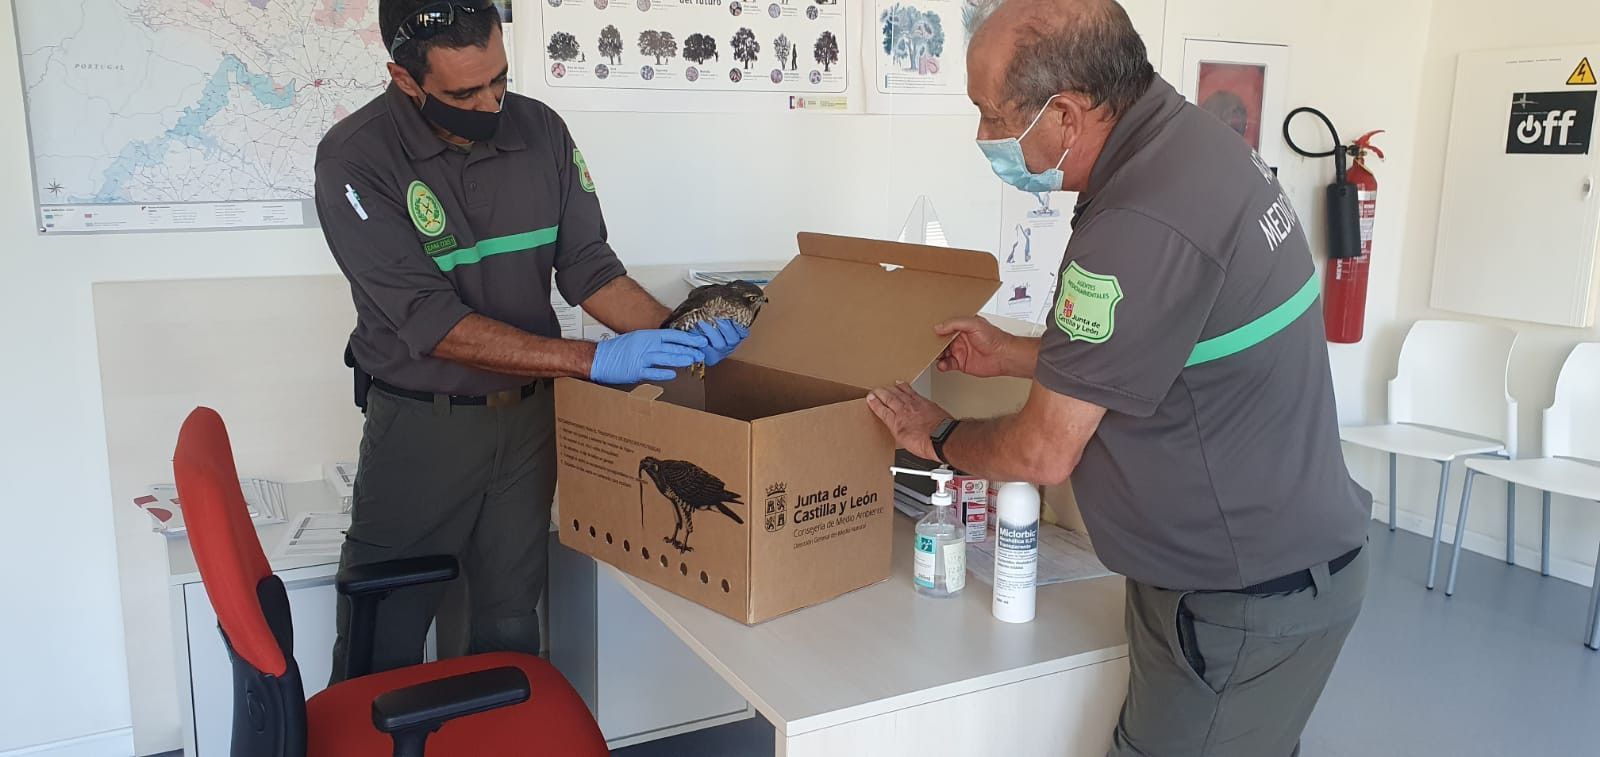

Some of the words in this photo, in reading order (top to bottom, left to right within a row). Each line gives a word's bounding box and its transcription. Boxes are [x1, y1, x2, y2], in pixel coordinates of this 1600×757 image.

[74, 63, 125, 71] PORTUGAL
[1516, 109, 1577, 146] off
[1258, 192, 1297, 252] MEDI
[1076, 279, 1096, 291] AGENTES
[1072, 314, 1090, 326] Junta
[1091, 321, 1101, 330] de
[1076, 323, 1081, 331] y
[1081, 325, 1099, 336] León
[793, 503, 837, 525] Castilla
[838, 500, 847, 516] y
[850, 491, 878, 509] León
[794, 490, 829, 509] Junta
[832, 485, 848, 499] de
[793, 523, 826, 540] Consejería
[826, 518, 835, 530] de
[835, 514, 855, 527] Medio
[855, 507, 884, 520] Ambiente
